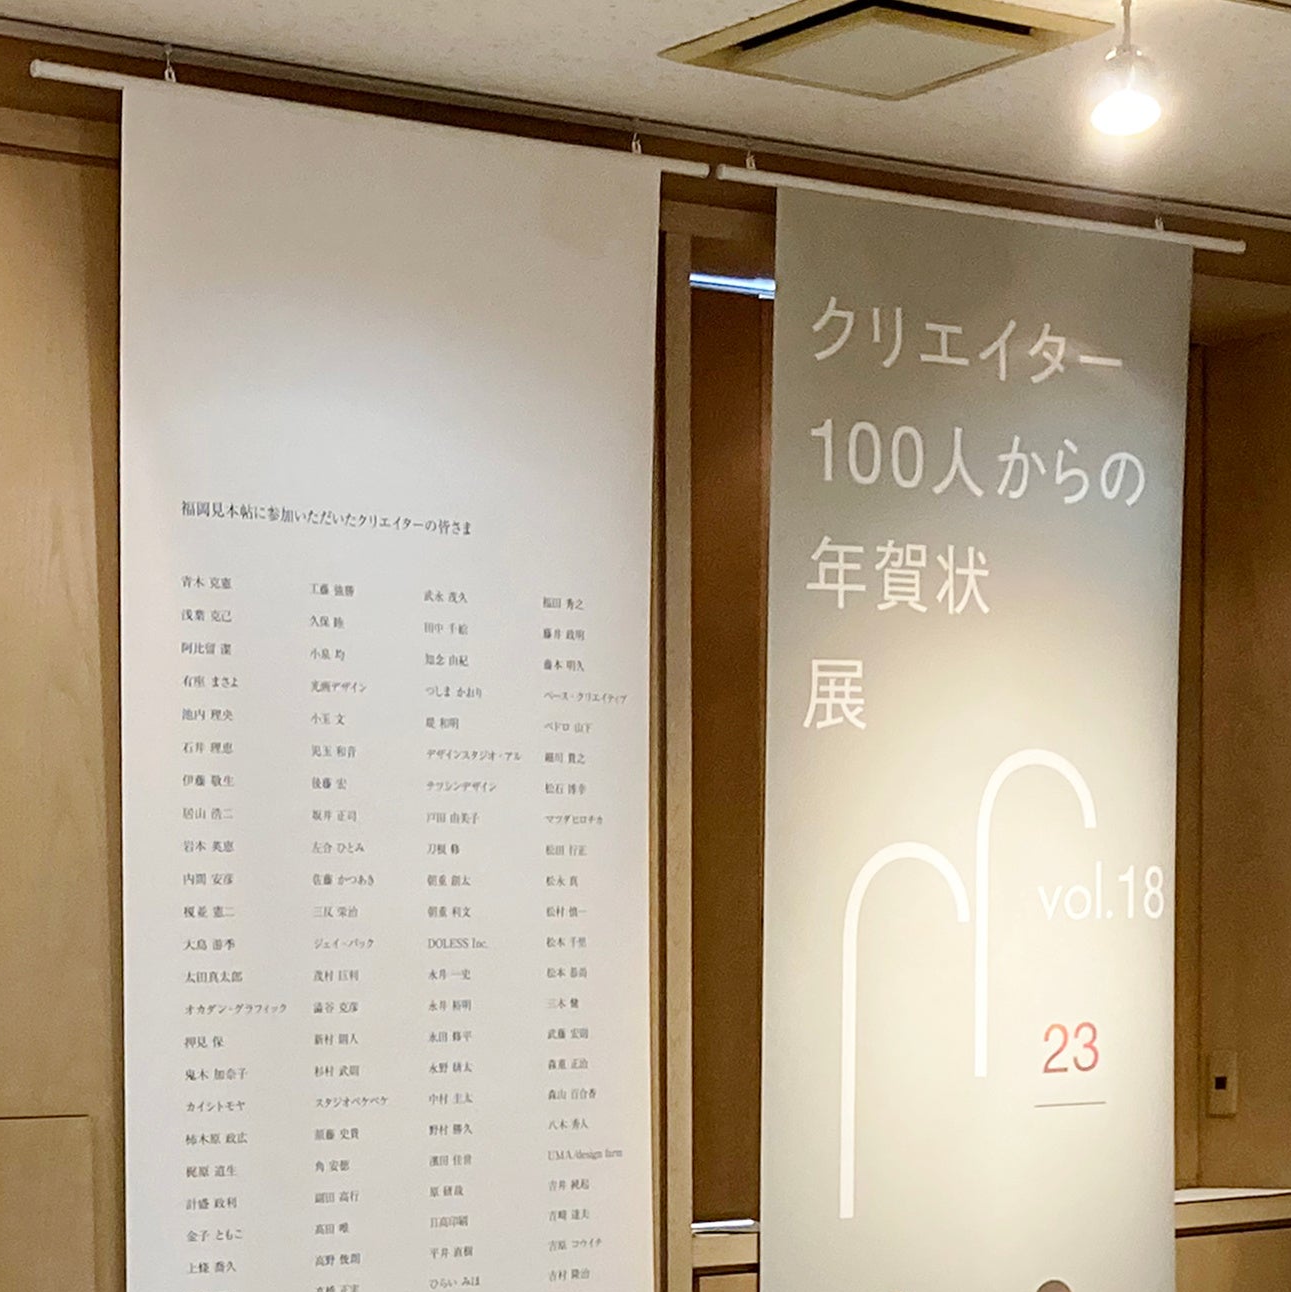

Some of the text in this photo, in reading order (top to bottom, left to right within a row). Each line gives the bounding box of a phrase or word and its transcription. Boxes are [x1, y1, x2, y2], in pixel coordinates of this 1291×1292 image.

[811, 296, 1123, 384] クリエイター
[810, 418, 1146, 506] 100人からの
[181, 500, 472, 537] 福岡見本帖に参加いただいたクリエイターの皆さま
[806, 535, 990, 615] 年賀状
[802, 658, 867, 730] 展
[1037, 860, 1166, 921] vol.18
[1041, 1021, 1101, 1075] 23
